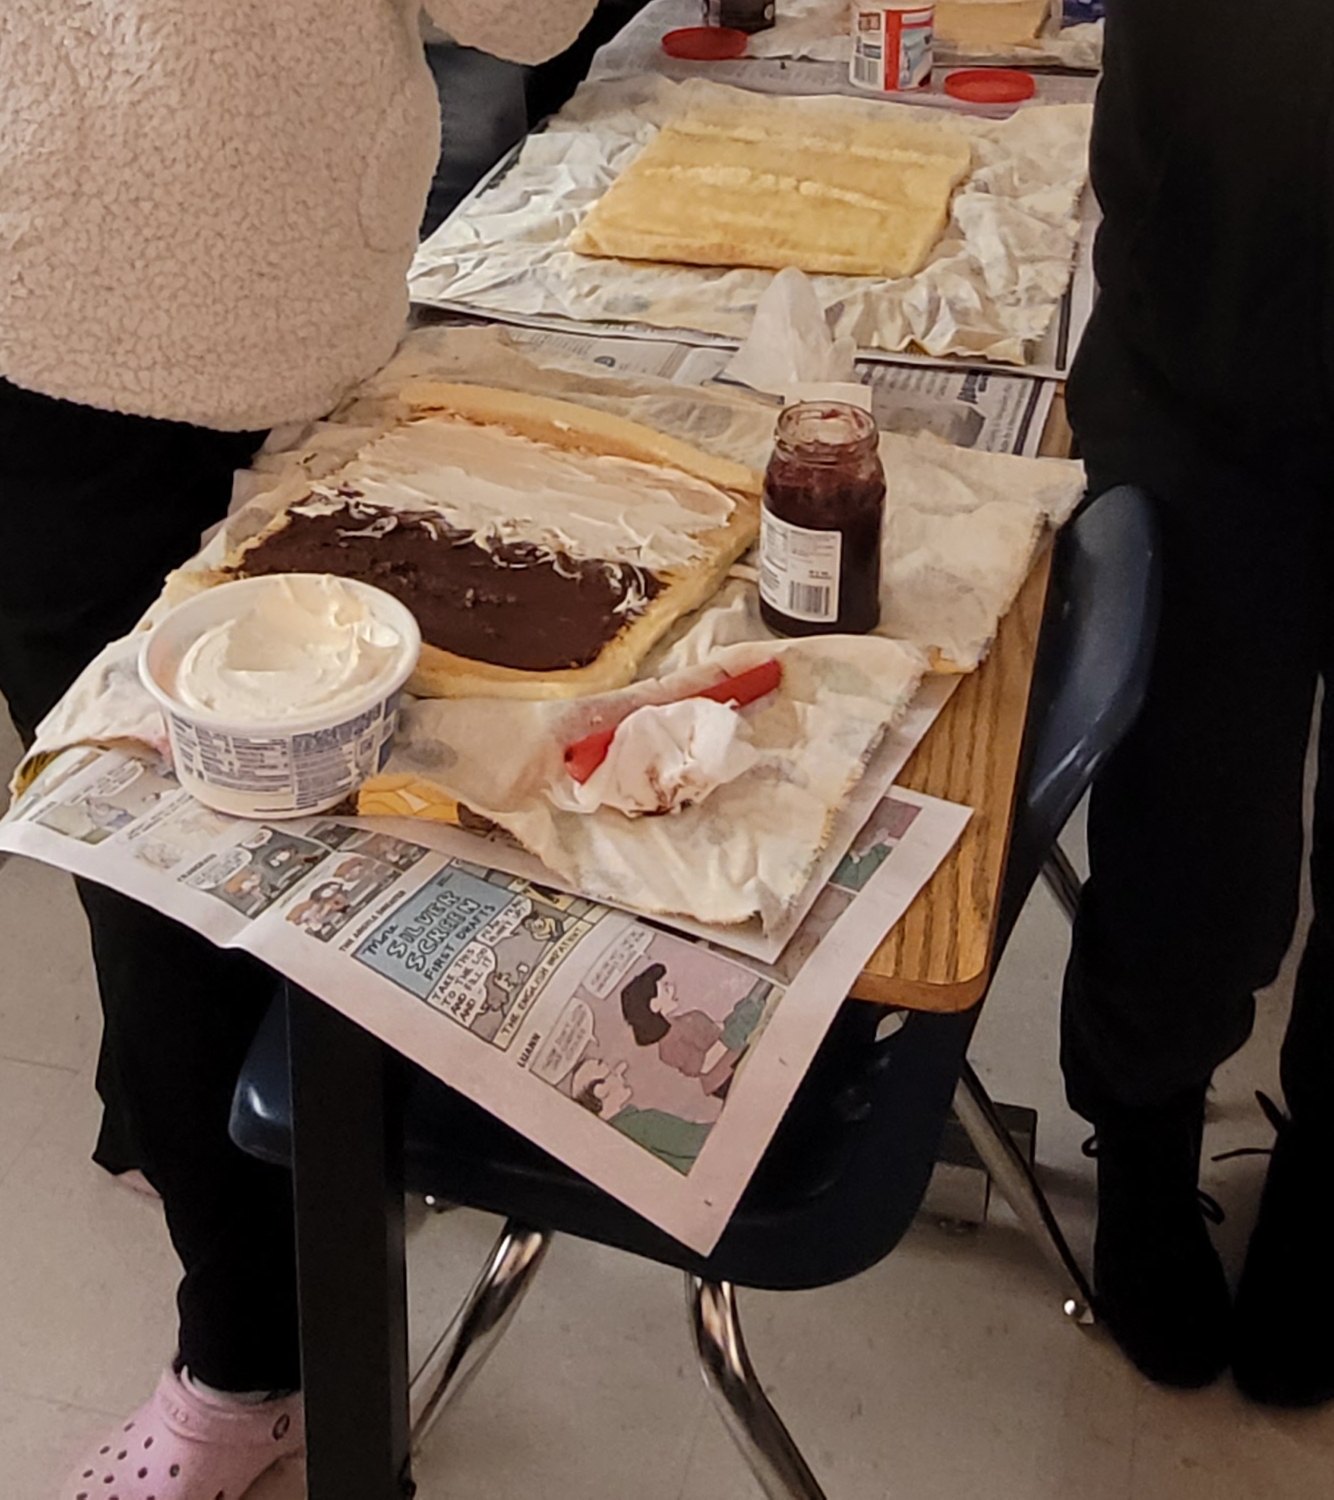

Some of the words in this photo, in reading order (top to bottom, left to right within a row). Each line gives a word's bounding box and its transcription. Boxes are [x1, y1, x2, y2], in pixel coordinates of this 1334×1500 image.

[386, 890, 460, 959] SILVER
[406, 898, 481, 972] SCREEN
[424, 944, 455, 982] FIRST
[432, 967, 455, 1001] TAKE
[441, 989, 457, 1007] TO
[500, 1011, 520, 1034] THE
[516, 965, 549, 1009] ENGLISH
[451, 991, 468, 1016] AND
[517, 1032, 541, 1068] LUANN
